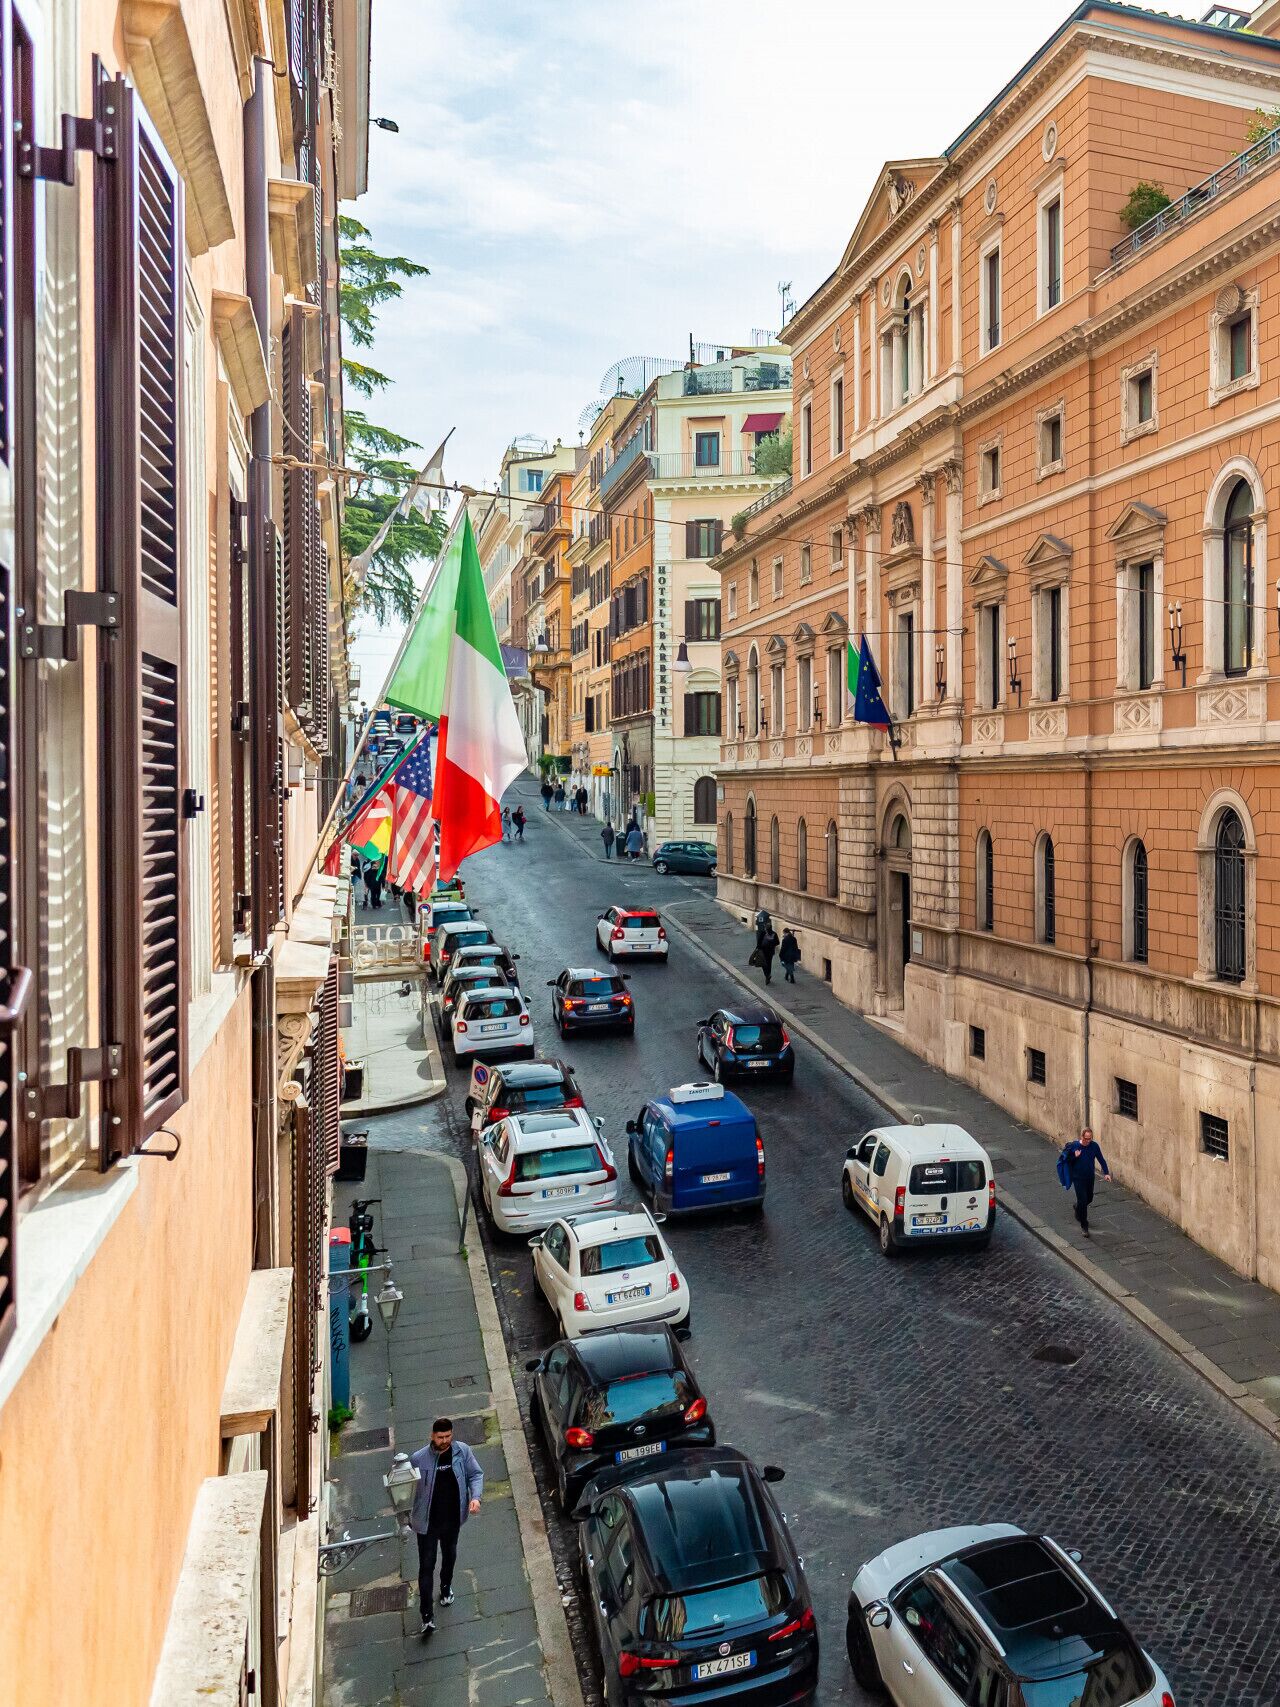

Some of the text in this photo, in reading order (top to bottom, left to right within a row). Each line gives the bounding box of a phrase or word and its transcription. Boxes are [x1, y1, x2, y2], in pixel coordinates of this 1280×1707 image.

[658, 566, 668, 727] HOTEL BARBERINI
[910, 1223, 981, 1235] SICURITALIA
[621, 1443, 661, 1460] DL 199EE
[699, 1653, 750, 1677] FX 471SF
